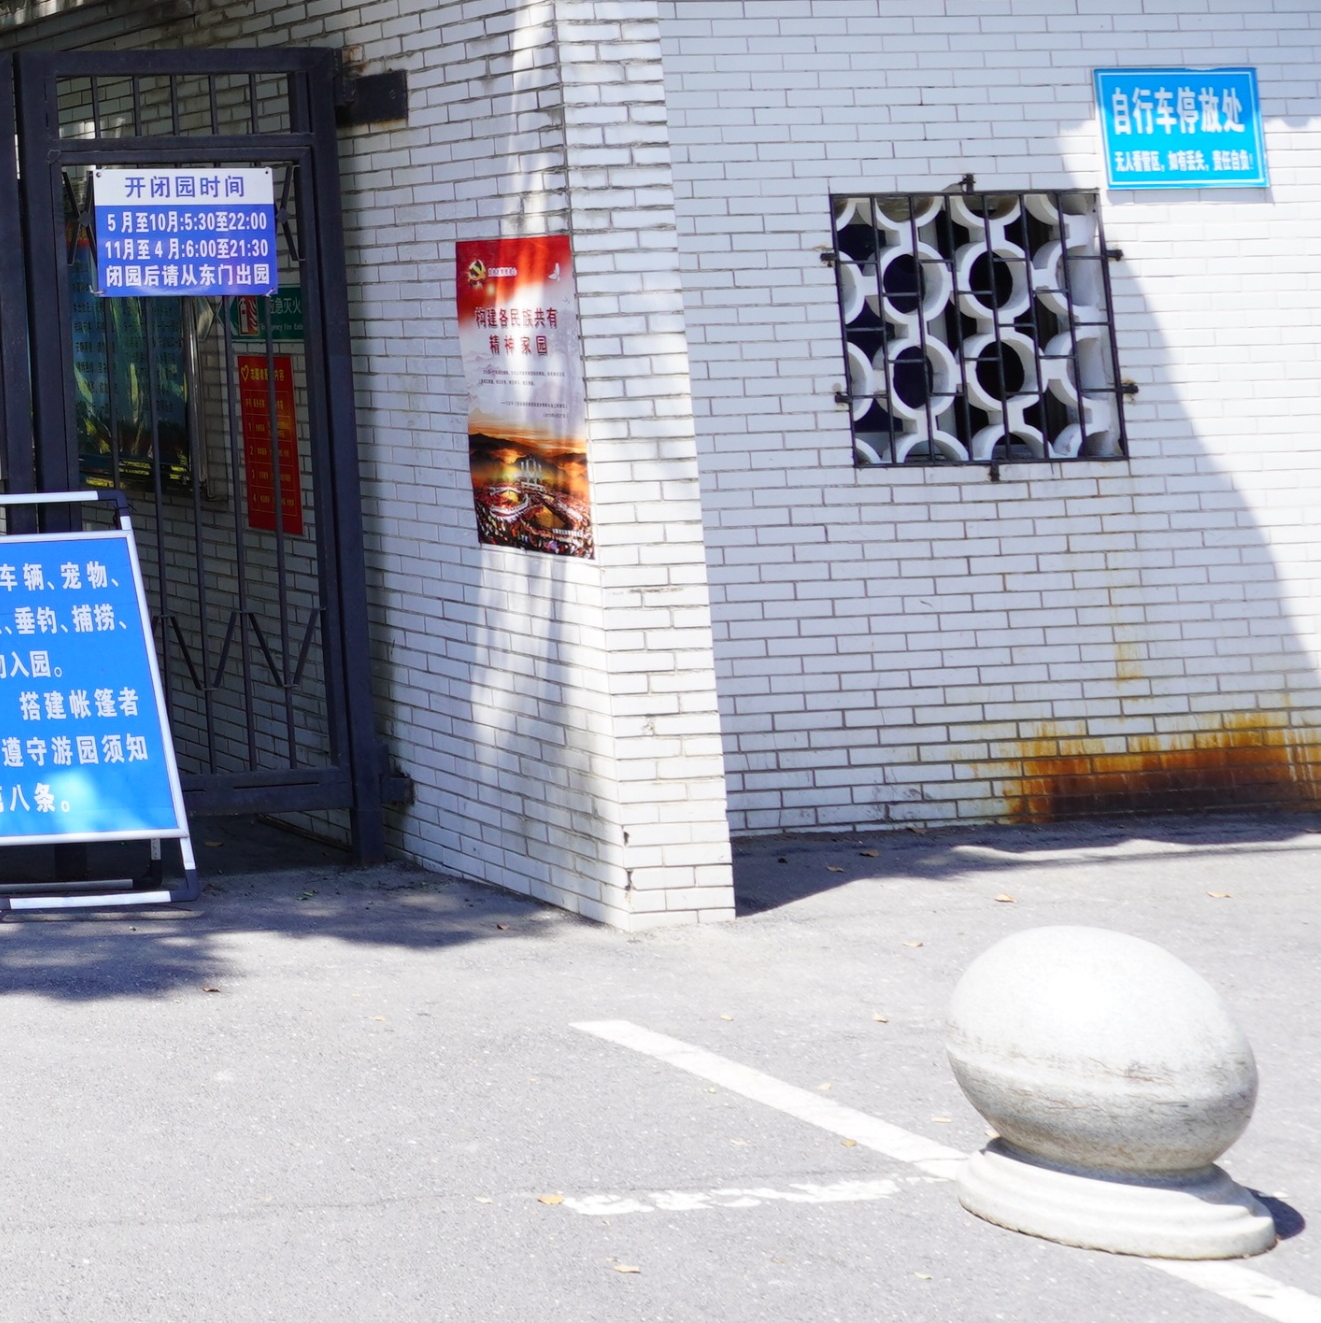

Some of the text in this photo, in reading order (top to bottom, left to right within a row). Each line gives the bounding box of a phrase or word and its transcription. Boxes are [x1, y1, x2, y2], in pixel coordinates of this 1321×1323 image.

[1111, 85, 1245, 135] 自行车停放处
[124, 175, 245, 198] 开闭园时间
[106, 263, 270, 287] 闭园后请从东门出园
[474, 306, 559, 330] 构建各民族共有
[489, 335, 549, 356] 精神家园
[19, 687, 139, 721] 搭建帐篷者
